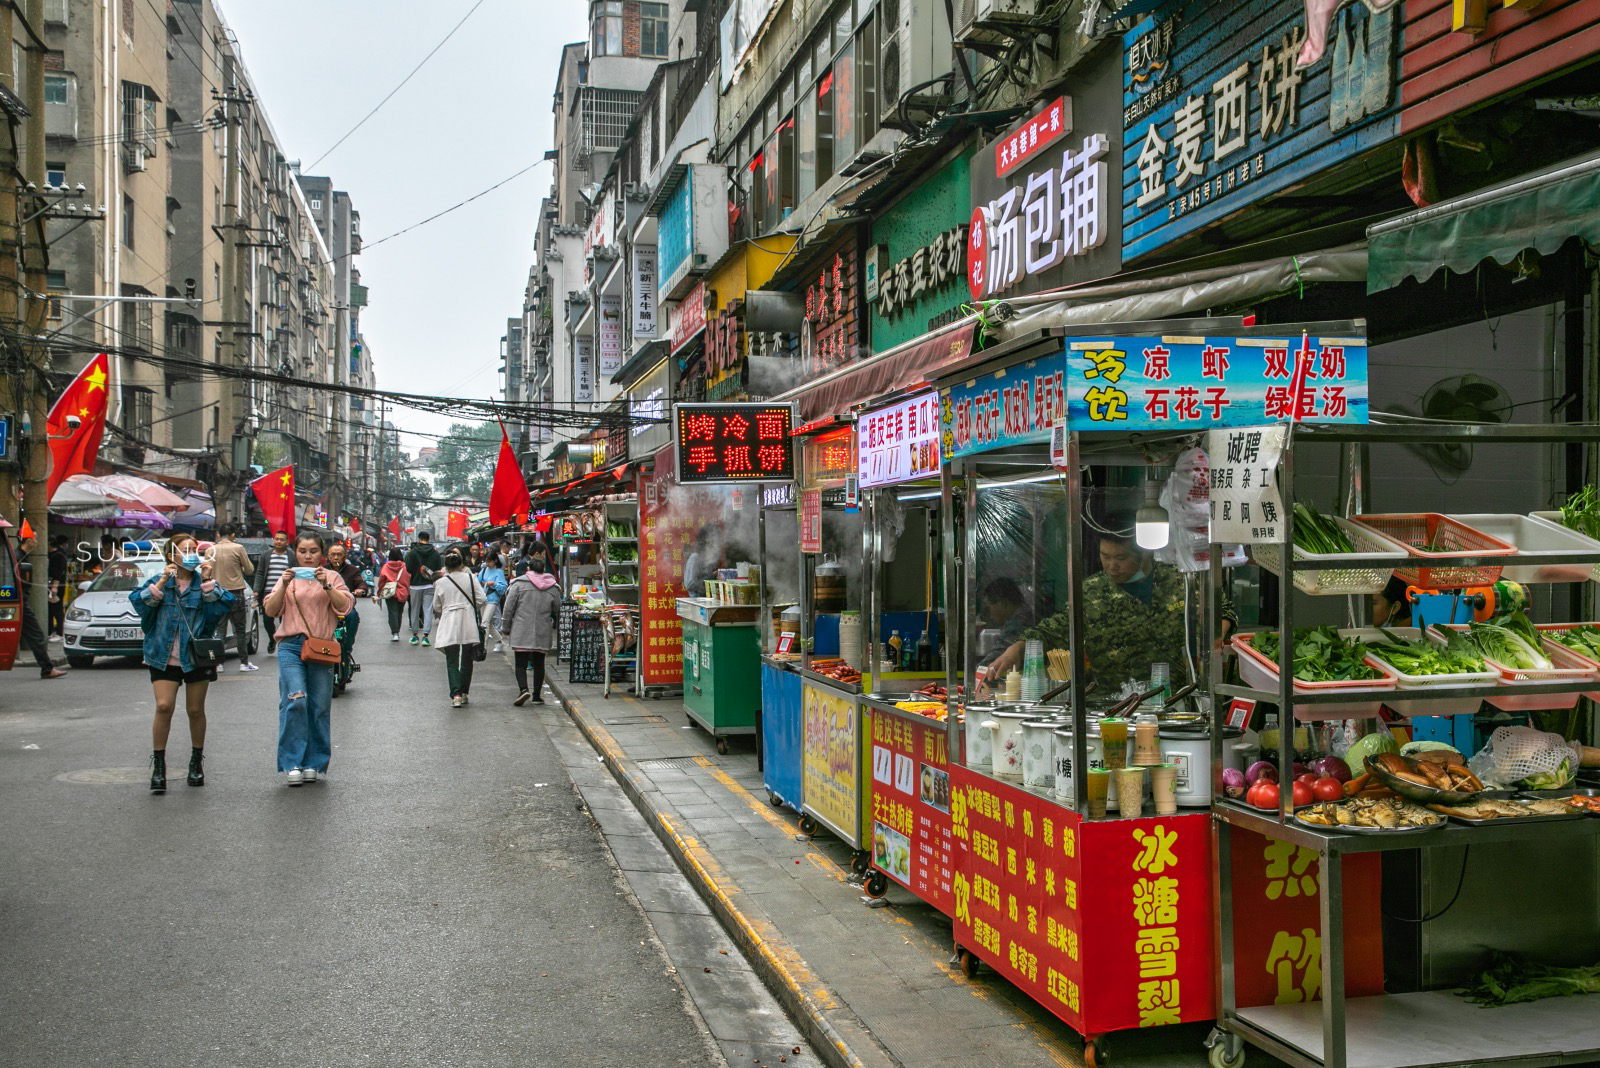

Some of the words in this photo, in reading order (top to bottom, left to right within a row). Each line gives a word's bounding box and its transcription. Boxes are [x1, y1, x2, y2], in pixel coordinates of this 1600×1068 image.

[1001, 106, 1060, 168] 大赛巷第一家
[1137, 26, 1302, 208] 金麦西饼
[987, 133, 1109, 295] 汤包铺
[971, 220, 983, 286] 杨记
[975, 388, 1000, 444] 石花子
[1003, 379, 1031, 437] 双皮奶
[1033, 370, 1065, 432] 绿豆汤
[1083, 348, 1129, 422] 冷饮
[1263, 345, 1347, 380] 双皮奶
[1144, 386, 1231, 420] 石花子
[1263, 386, 1348, 419] 绿豆汤
[686, 413, 785, 441] 烤冷面
[687, 444, 786, 472] 手抓饼
[1227, 431, 1262, 464] 诚聘
[1210, 468, 1234, 489] 服务员
[874, 711, 914, 753] 脆皮年糕
[873, 791, 914, 838] 芝士热狗棒
[951, 785, 971, 929] 热饮
[965, 783, 1002, 823] 冰糖雪梨
[972, 829, 999, 867] 绿豆汤
[973, 872, 1001, 912] 银耳汤
[1046, 916, 1079, 962] 黑米粥
[1132, 824, 1182, 1028] 冰糖雪梨
[973, 916, 1001, 957] 燕麦粥
[1009, 940, 1038, 984] 龟苓膏
[1046, 966, 1080, 1014] 红豆粥
